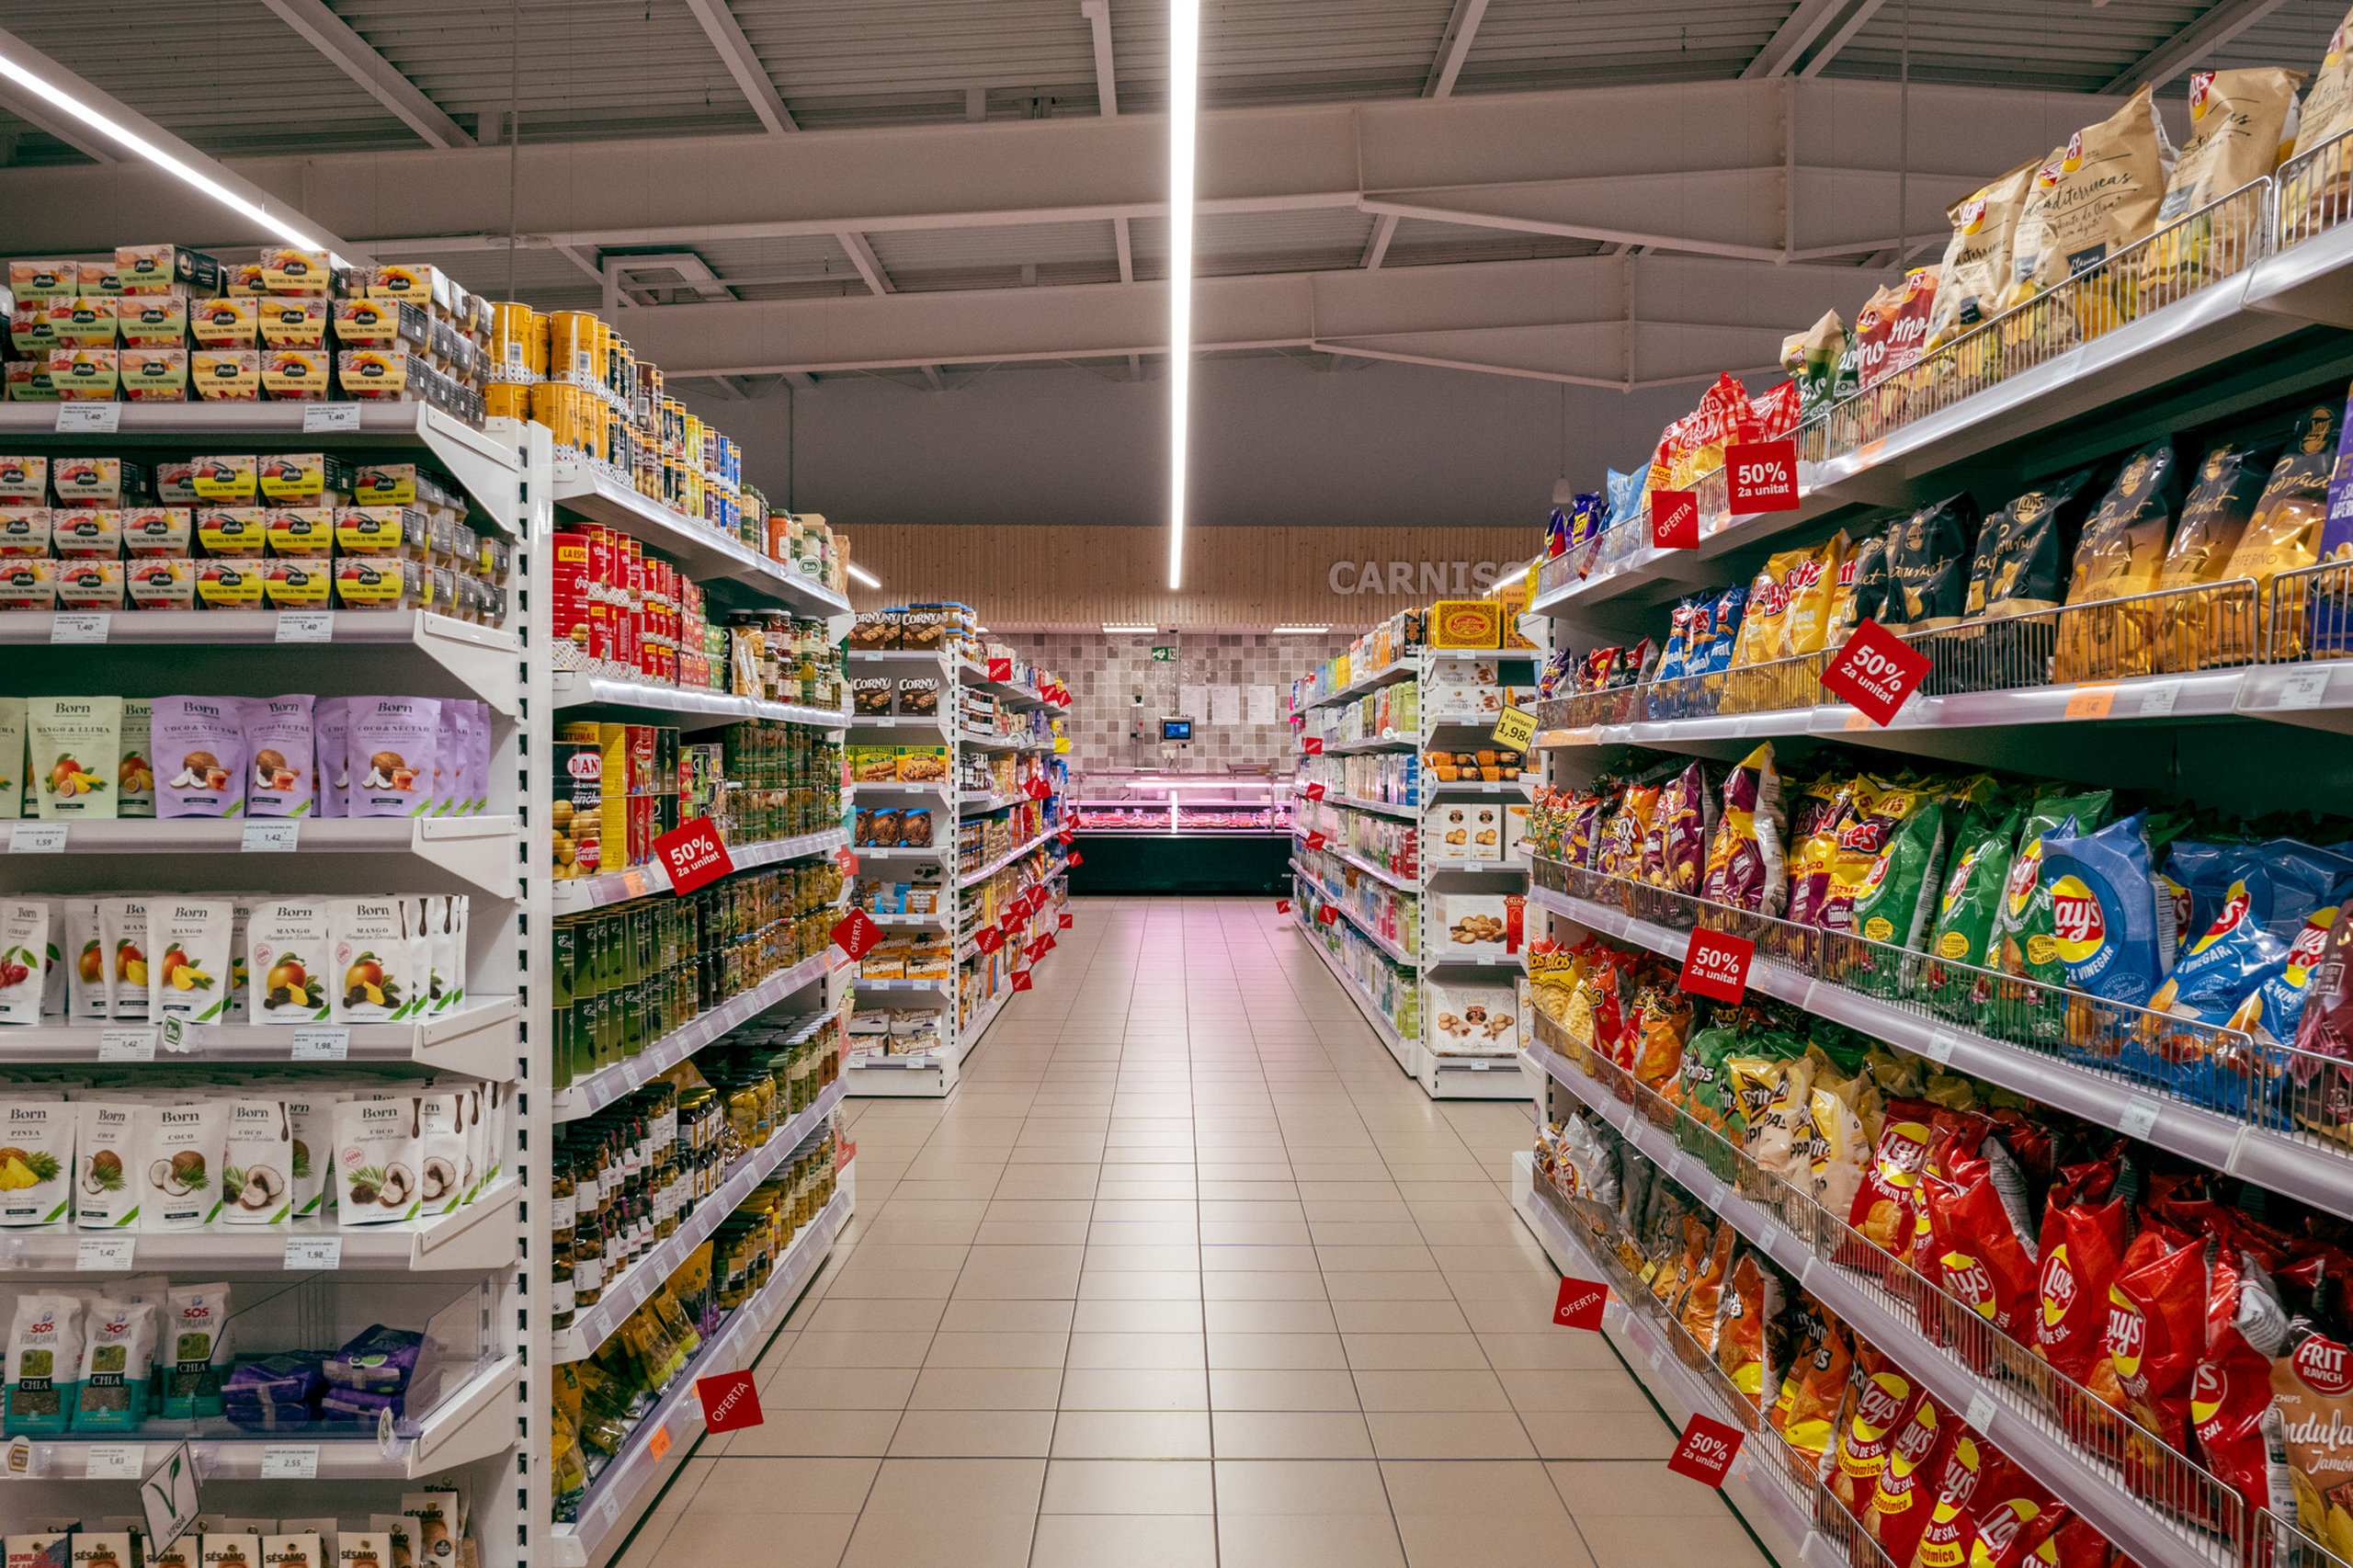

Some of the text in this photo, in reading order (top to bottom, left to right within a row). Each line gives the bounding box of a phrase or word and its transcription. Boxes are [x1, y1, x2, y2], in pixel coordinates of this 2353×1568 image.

[1738, 461, 1788, 484] 50%
[1737, 483, 1790, 497] 2a unitat
[1658, 503, 1692, 538] OFERTA
[902, 613, 941, 626] CORNY
[1851, 644, 1908, 693] 50%
[853, 677, 892, 691] CORNY
[900, 677, 938, 691] CORNY
[1840, 661, 1895, 706] 2a unitat
[55, 702, 91, 713] Born
[184, 701, 220, 715] Born
[269, 702, 300, 713] Born
[378, 702, 413, 714] Born
[1510, 714, 1533, 729] Unitats
[670, 834, 715, 868] 50%
[676, 850, 721, 879] 2a unitat
[175, 906, 208, 918] Born
[277, 907, 313, 917] Born
[357, 904, 390, 916] Born
[1509, 910, 1522, 925] 10
[2054, 896, 2104, 944] ay's
[850, 917, 864, 953] OFERTA
[983, 930, 995, 950] OFERTA
[1696, 947, 1740, 974] 50%
[2077, 946, 2114, 980] VINEGAR
[2187, 945, 2233, 971] VINEGAR
[1690, 964, 1738, 986] 2a unitat
[315, 1042, 331, 1051] 1,98
[10, 1108, 47, 1119] Born
[98, 1108, 126, 1122] Born
[162, 1111, 199, 1123] Born
[236, 1107, 268, 1119] Born
[362, 1108, 398, 1119] Born
[307, 1251, 324, 1259] 1,98
[1560, 1291, 1601, 1318] OFERTA
[184, 1308, 210, 1318] SOS
[31, 1322, 55, 1333] SOS
[2299, 1342, 2347, 1372] FRIT
[178, 1362, 207, 1373] CHIA
[2303, 1366, 2343, 1383] RAVICH
[21, 1380, 49, 1391] CHIA
[93, 1375, 120, 1387] CHIA
[711, 1381, 749, 1423] OFERTA
[2274, 1393, 2302, 1404] CHIPS
[1688, 1432, 1729, 1462] 50%
[284, 1459, 301, 1468] 2,55
[1682, 1447, 1723, 1472] 2a unitat
[74, 1550, 116, 1561] SÉSAMO
[205, 1551, 246, 1562] SÉSAMO
[266, 1551, 307, 1562] SÉSAMO
[341, 1549, 378, 1561] SÉSAMO
